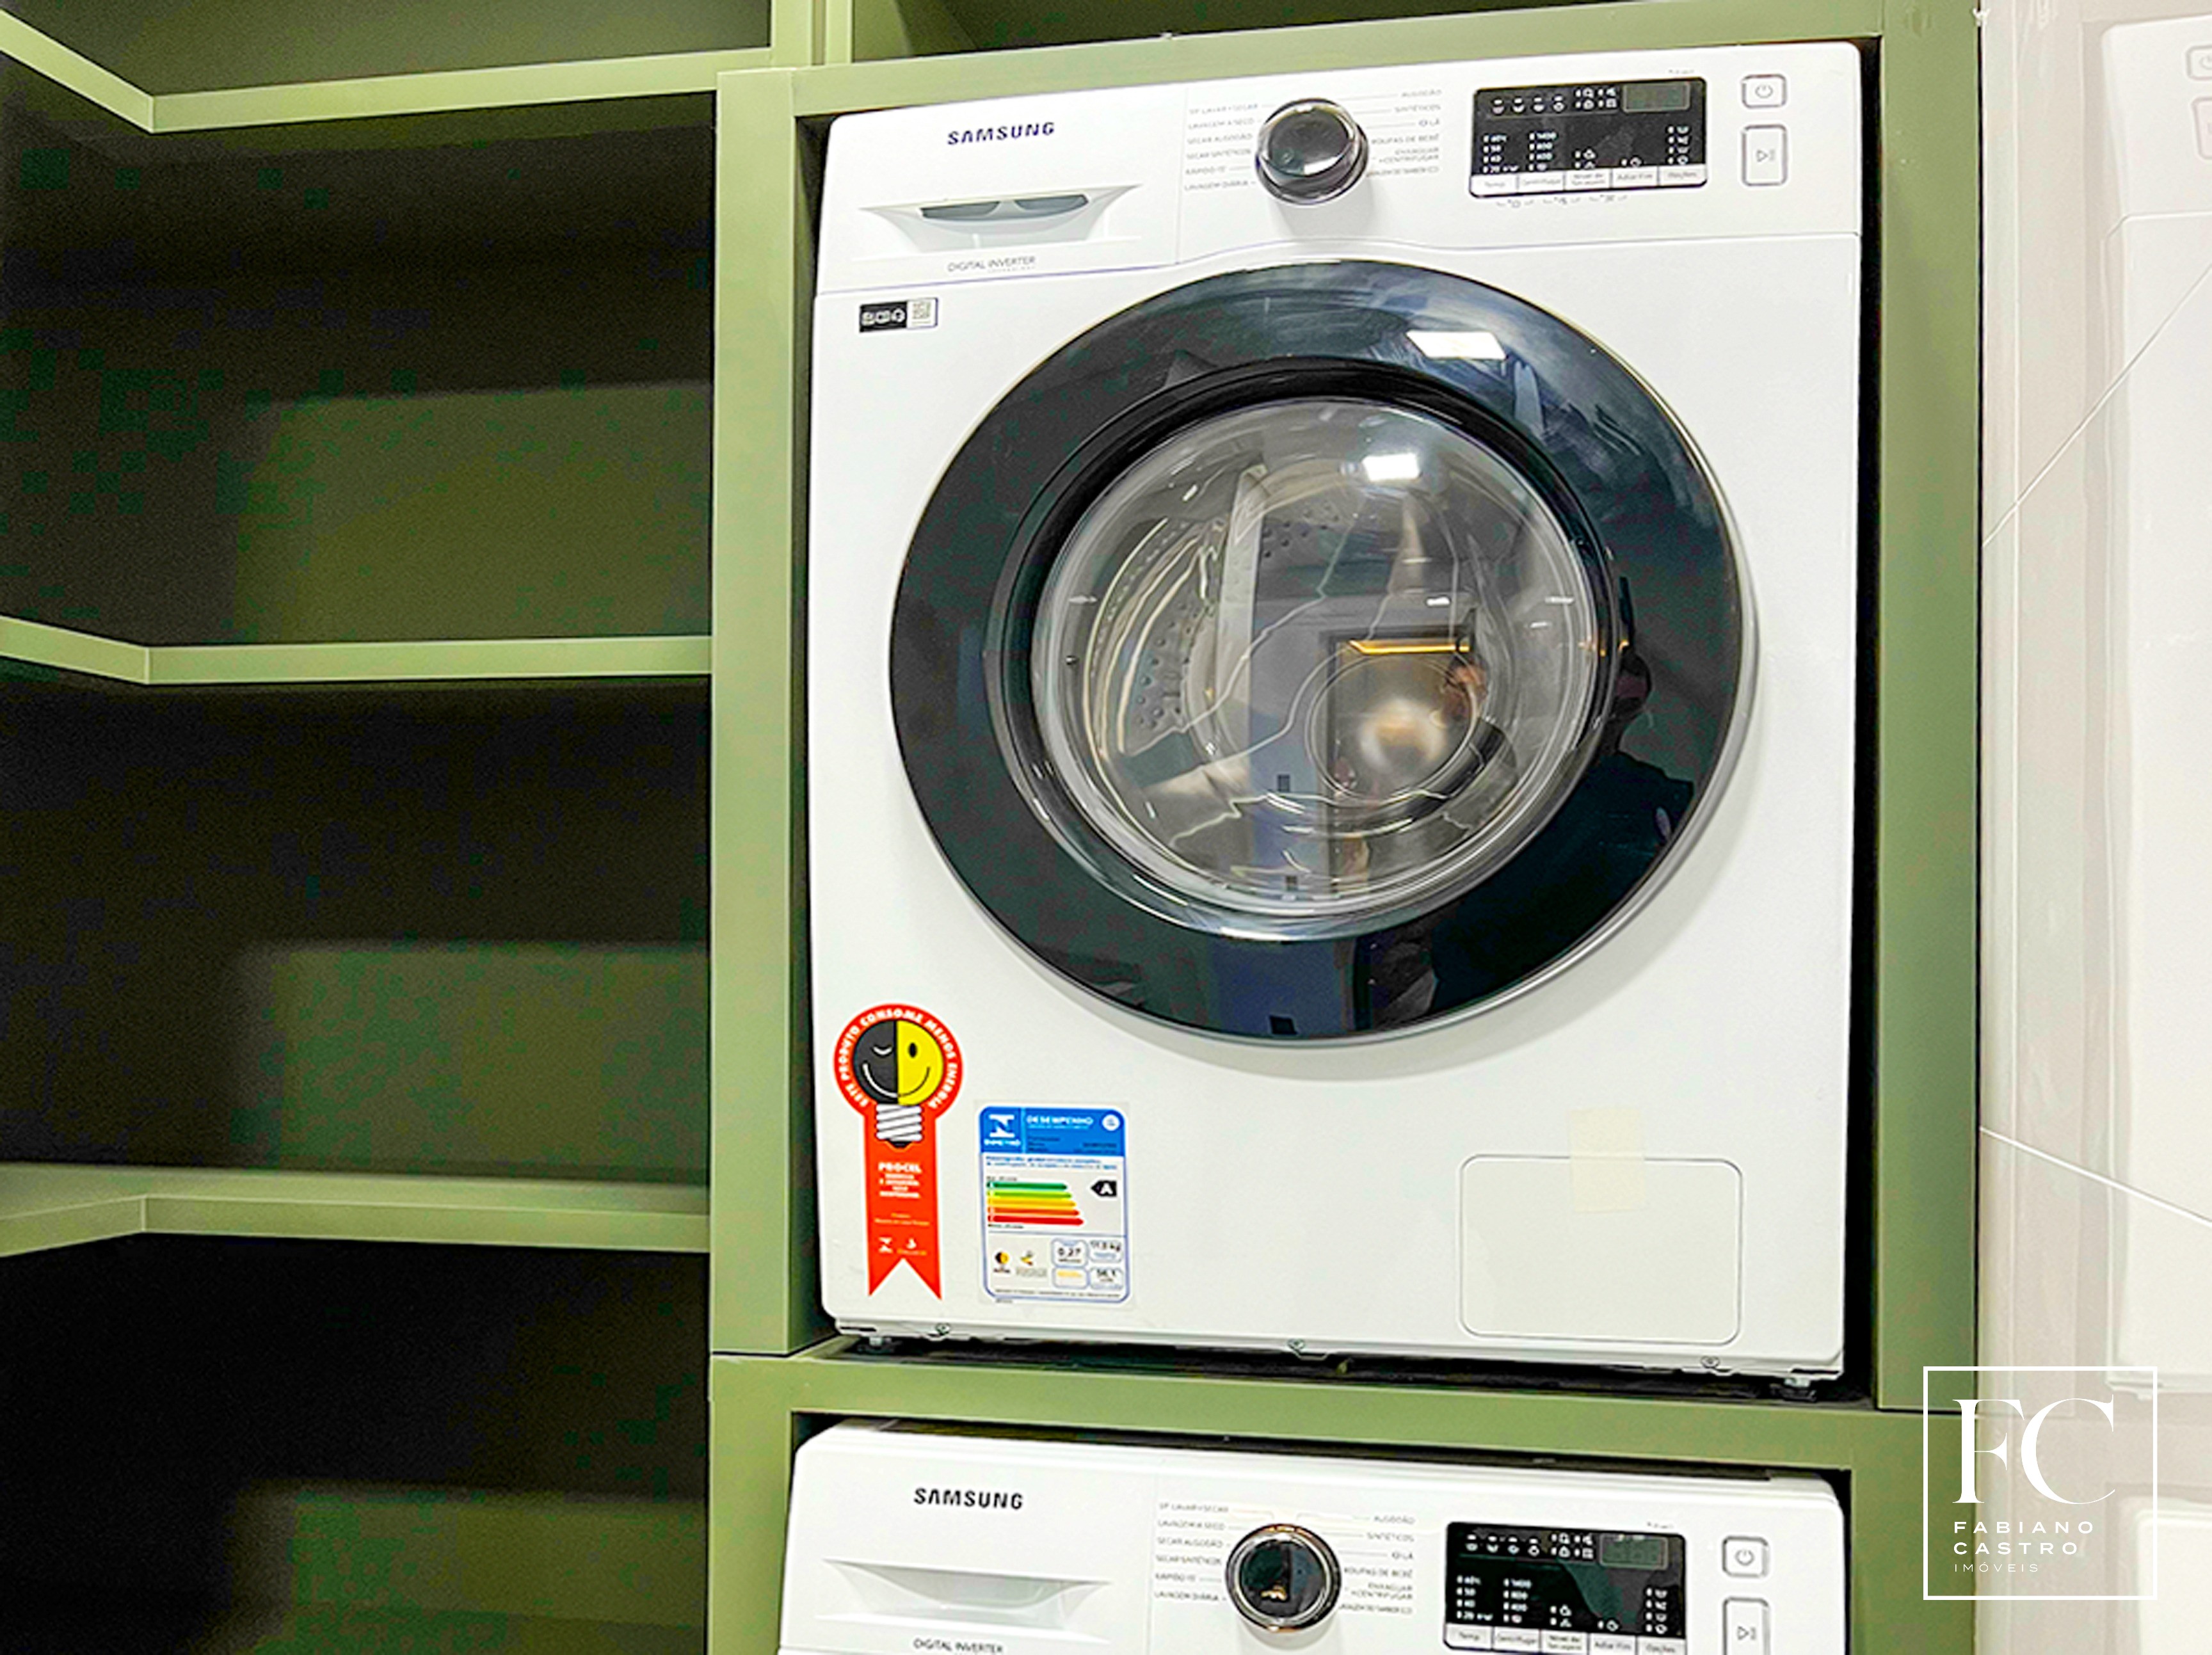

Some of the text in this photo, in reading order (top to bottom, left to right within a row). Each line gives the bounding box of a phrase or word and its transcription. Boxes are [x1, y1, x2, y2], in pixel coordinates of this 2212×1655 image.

[947, 122, 1055, 145] SAMSUNG
[947, 260, 986, 273] DIGITAL
[988, 256, 1036, 268] INVERTER
[860, 1008, 924, 1027] CONSOME
[924, 1019, 956, 1059] MENOS
[928, 1063, 958, 1108] ENERGIA
[913, 1487, 1023, 1510] SAMSUNG
[913, 1638, 1004, 1654] DIGITAL INVERTER
